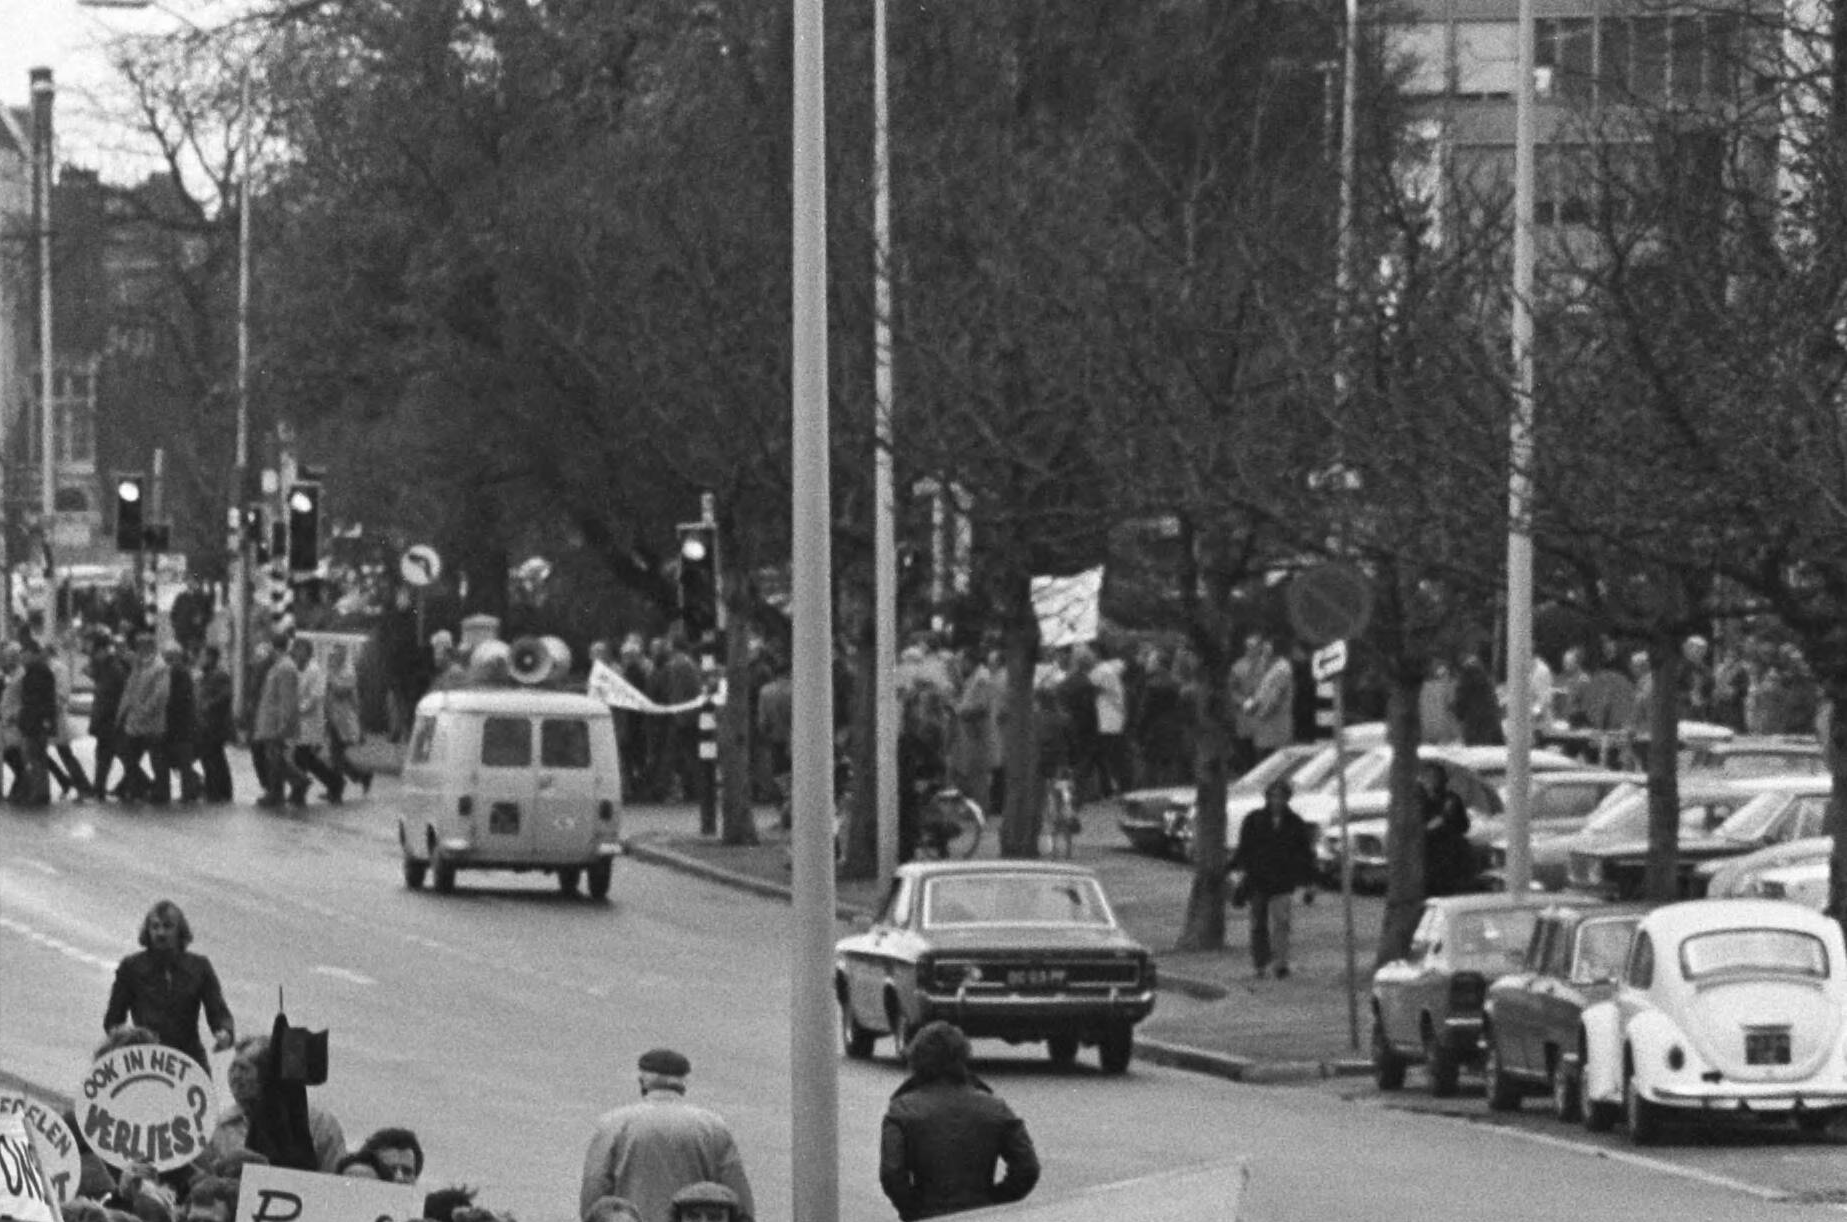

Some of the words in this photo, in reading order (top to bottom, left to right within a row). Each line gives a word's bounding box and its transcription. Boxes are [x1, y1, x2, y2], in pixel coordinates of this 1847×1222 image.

[83, 1058, 118, 1099] OOK
[123, 1049, 145, 1074] IN
[150, 1052, 192, 1082] HET
